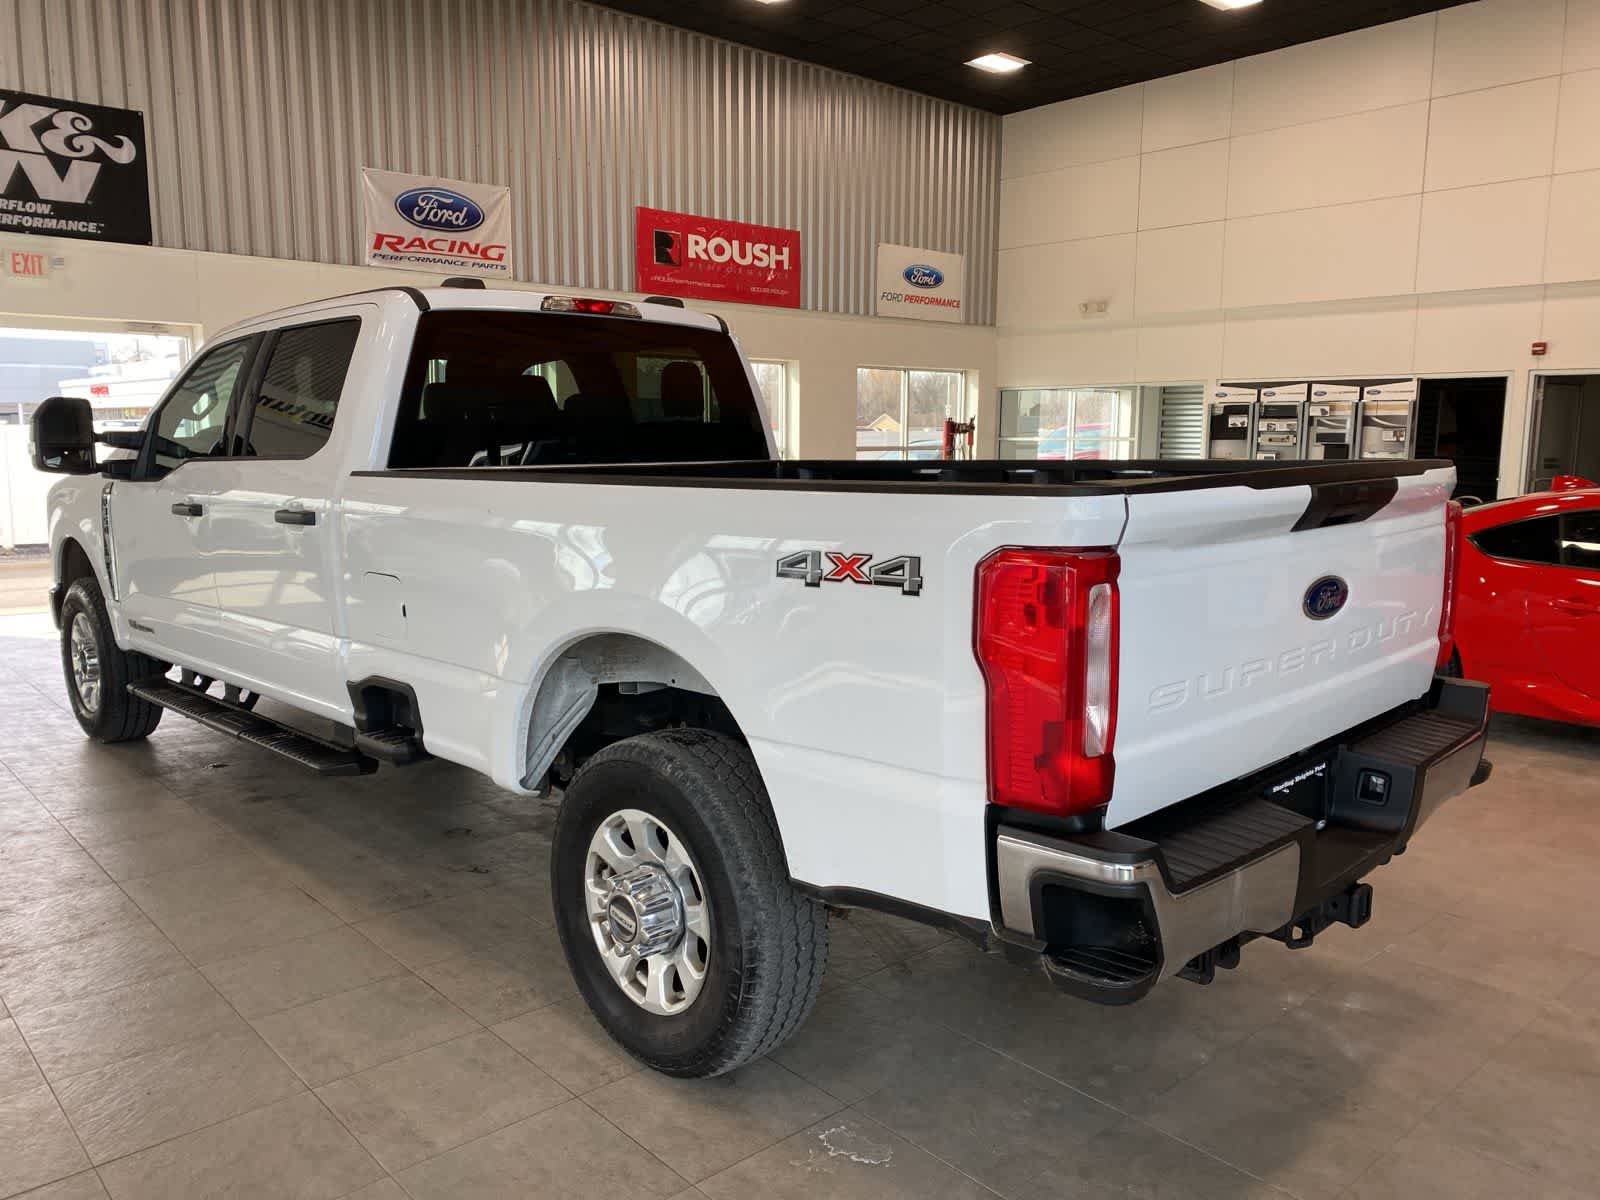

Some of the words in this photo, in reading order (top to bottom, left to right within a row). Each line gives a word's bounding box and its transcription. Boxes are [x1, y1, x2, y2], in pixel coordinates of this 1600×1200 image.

[412, 193, 468, 226] Ford
[372, 233, 507, 262] RACING
[687, 233, 790, 271] ROUSH
[11, 251, 43, 275] EXIT
[372, 252, 470, 267] PERFORMANCE
[471, 262, 507, 271] PARTS
[910, 266, 936, 285] Ford
[880, 291, 904, 303] FORD
[903, 293, 961, 309] PERFORMANCE
